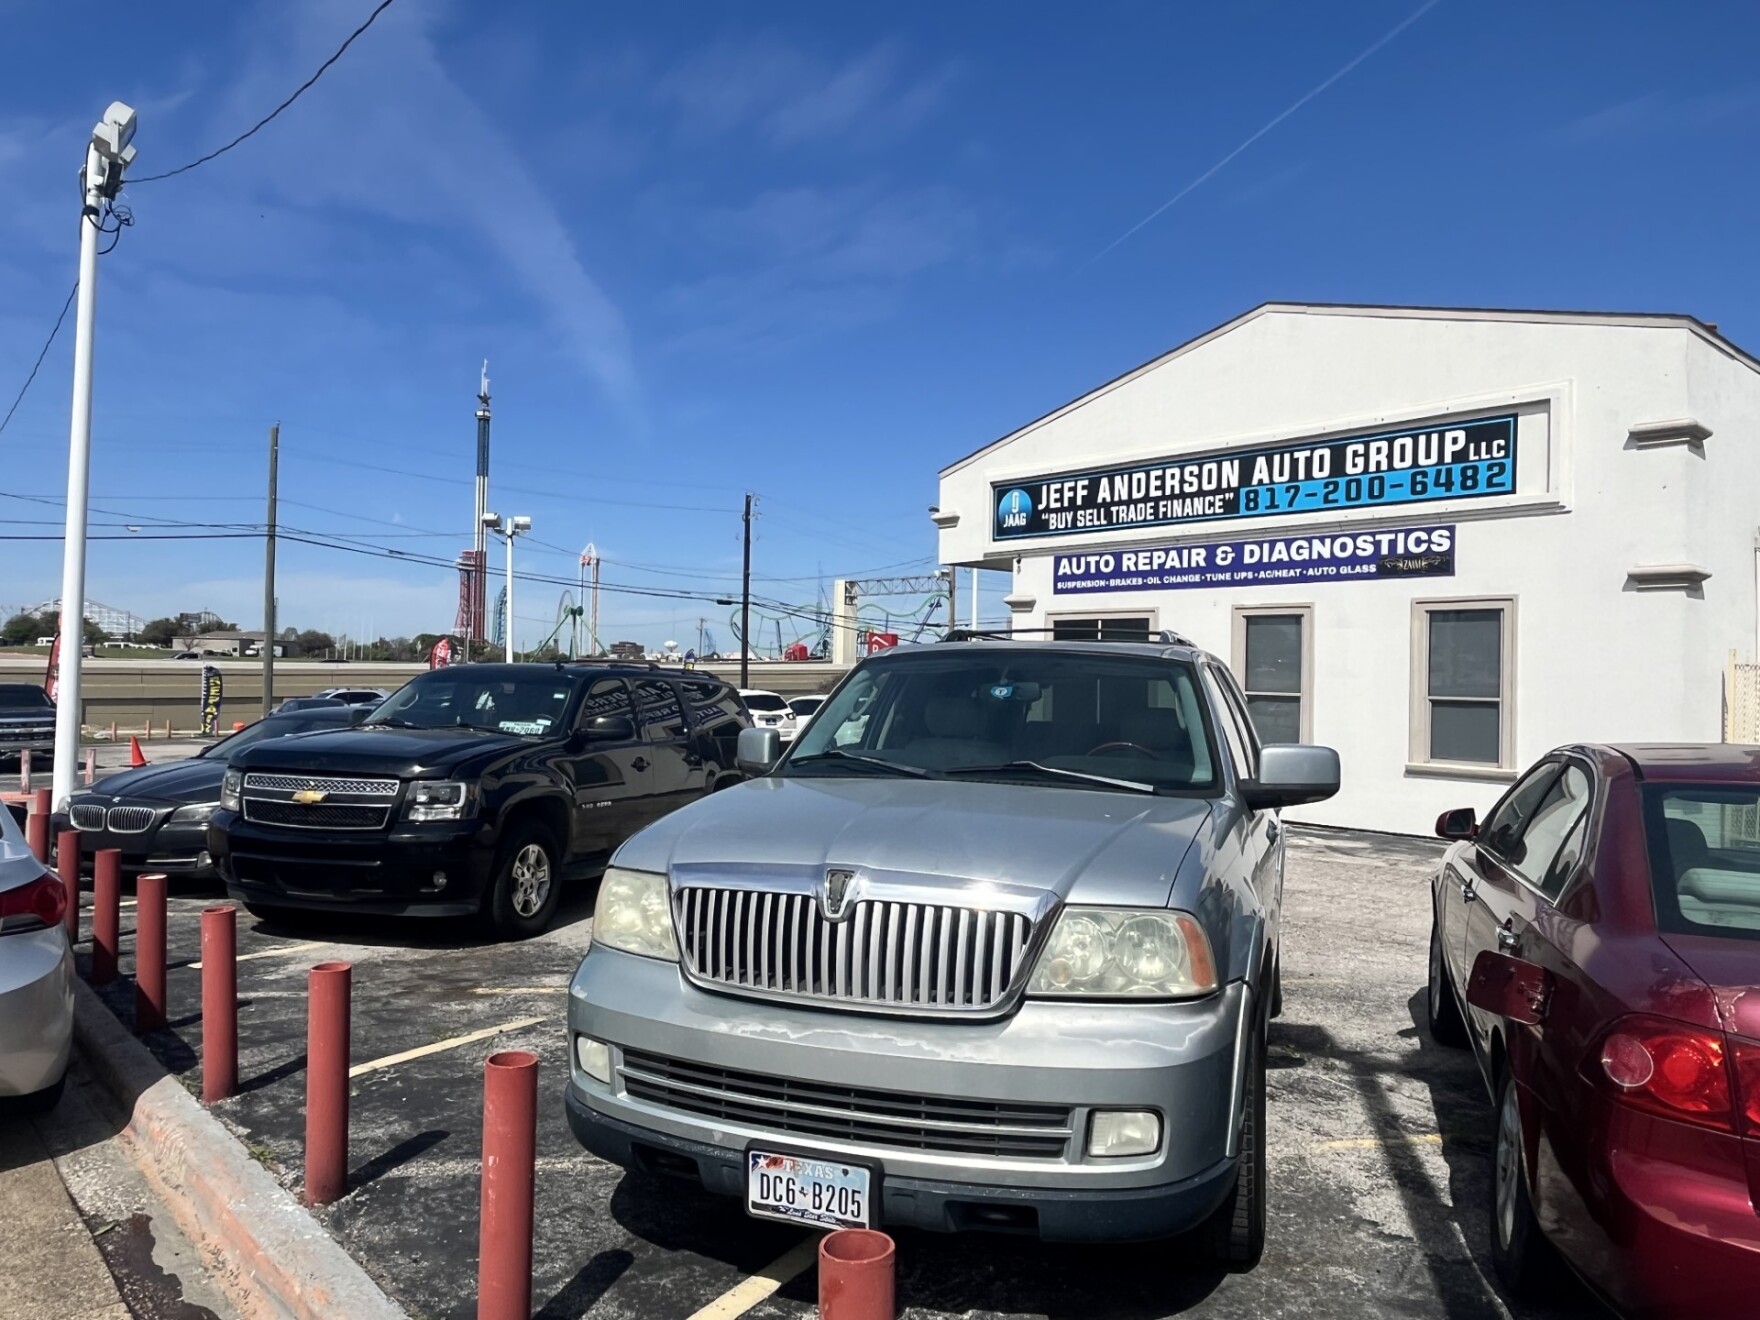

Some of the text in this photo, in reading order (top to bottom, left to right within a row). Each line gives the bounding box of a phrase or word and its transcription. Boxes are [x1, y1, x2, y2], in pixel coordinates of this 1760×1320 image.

[1038, 430, 1505, 511] JEFF ANDERSON AUTO GROUP LLC
[1244, 461, 1507, 512] 817-200-6482
[1003, 513, 1026, 528] JAAG
[1076, 508, 1107, 527] SELL
[1111, 503, 1155, 524] TRADE
[1058, 529, 1451, 576] AUTO REPAIR & DIAGNOSTICS
[1057, 564, 1377, 589] SUSPENSION BRAKES OIL CHANGE TUNE UPS AC/HEAT AUTO GLASS
[783, 1159, 834, 1179] TEXAS
